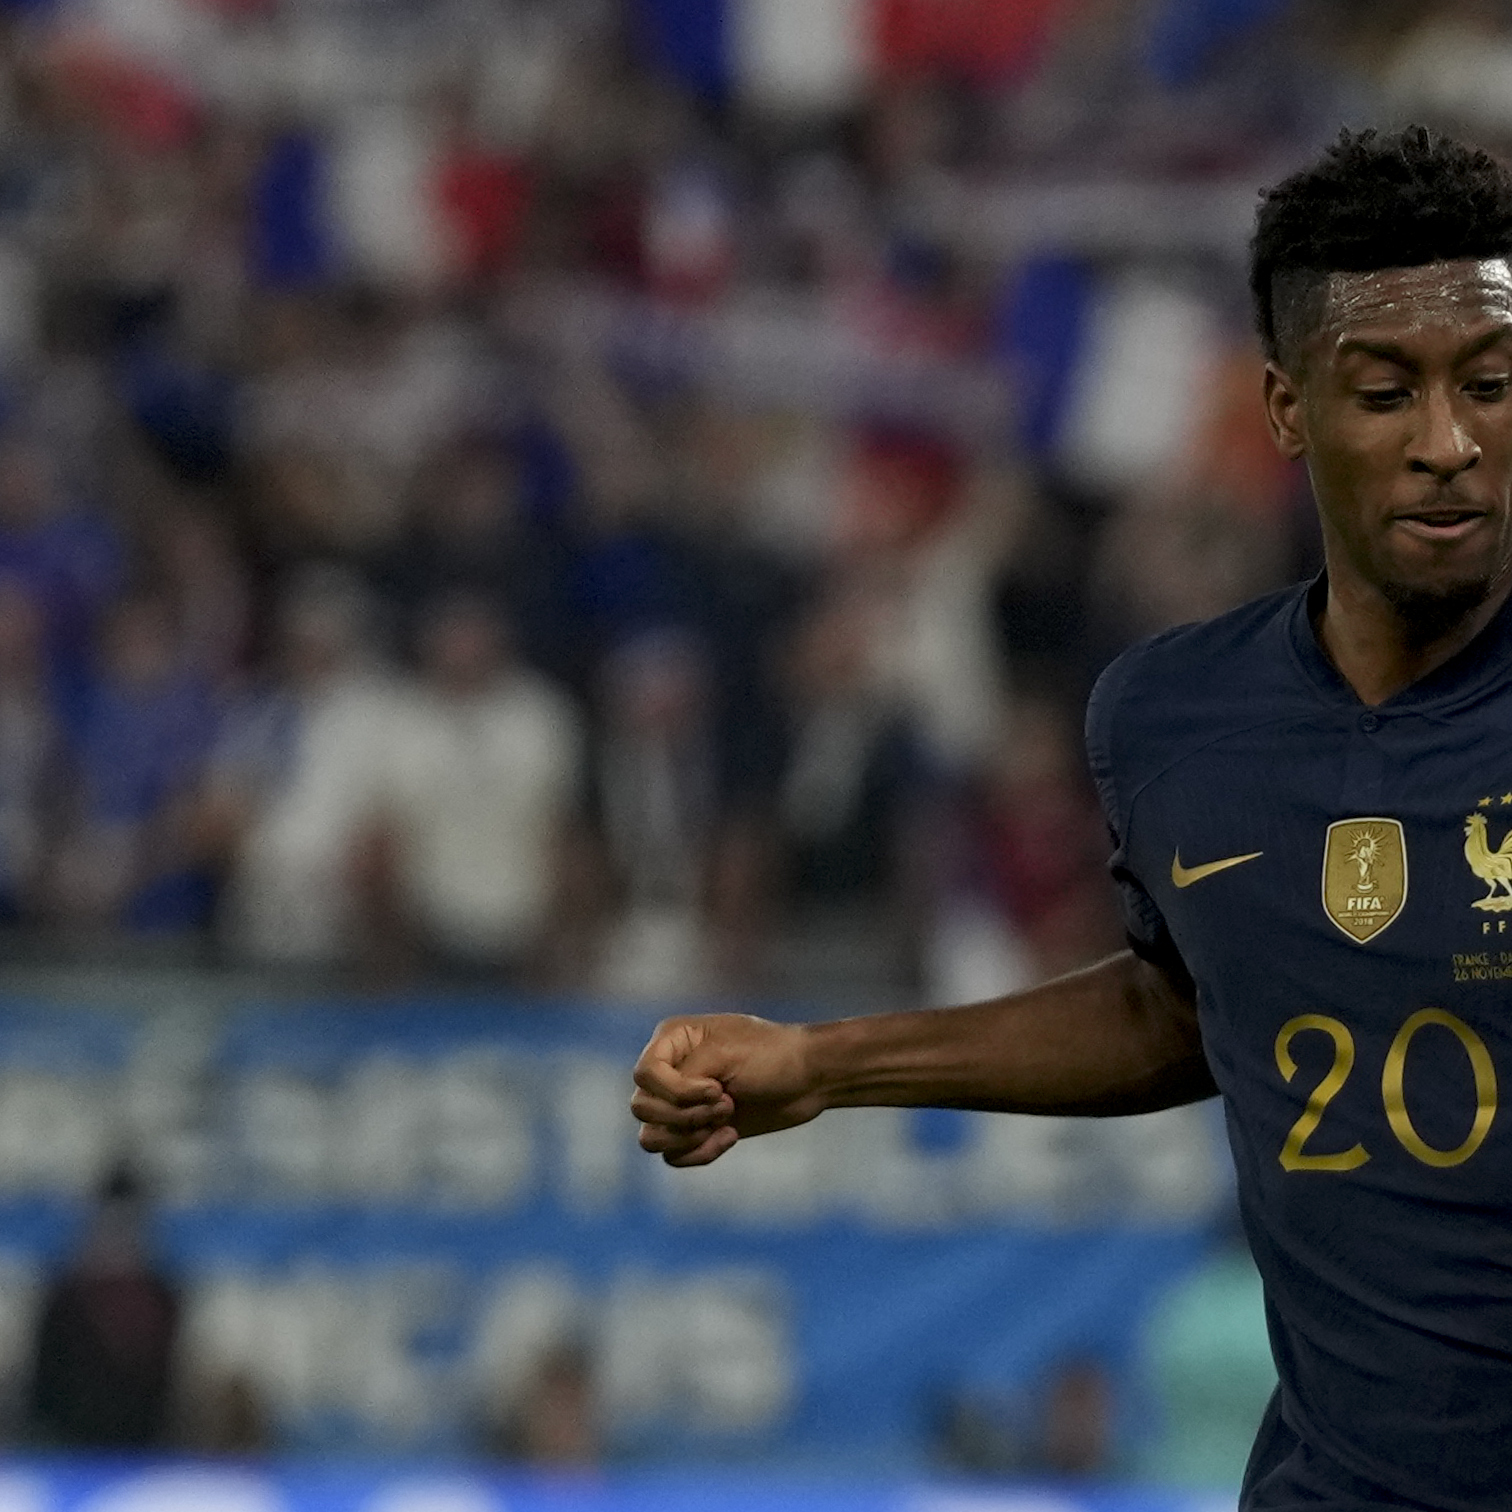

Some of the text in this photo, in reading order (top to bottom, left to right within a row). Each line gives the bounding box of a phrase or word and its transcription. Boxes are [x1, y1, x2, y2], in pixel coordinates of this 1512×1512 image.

[1347, 897, 1382, 911] FIFA
[1353, 918, 1374, 926] 2018
[1274, 1007, 1498, 1172] 20
